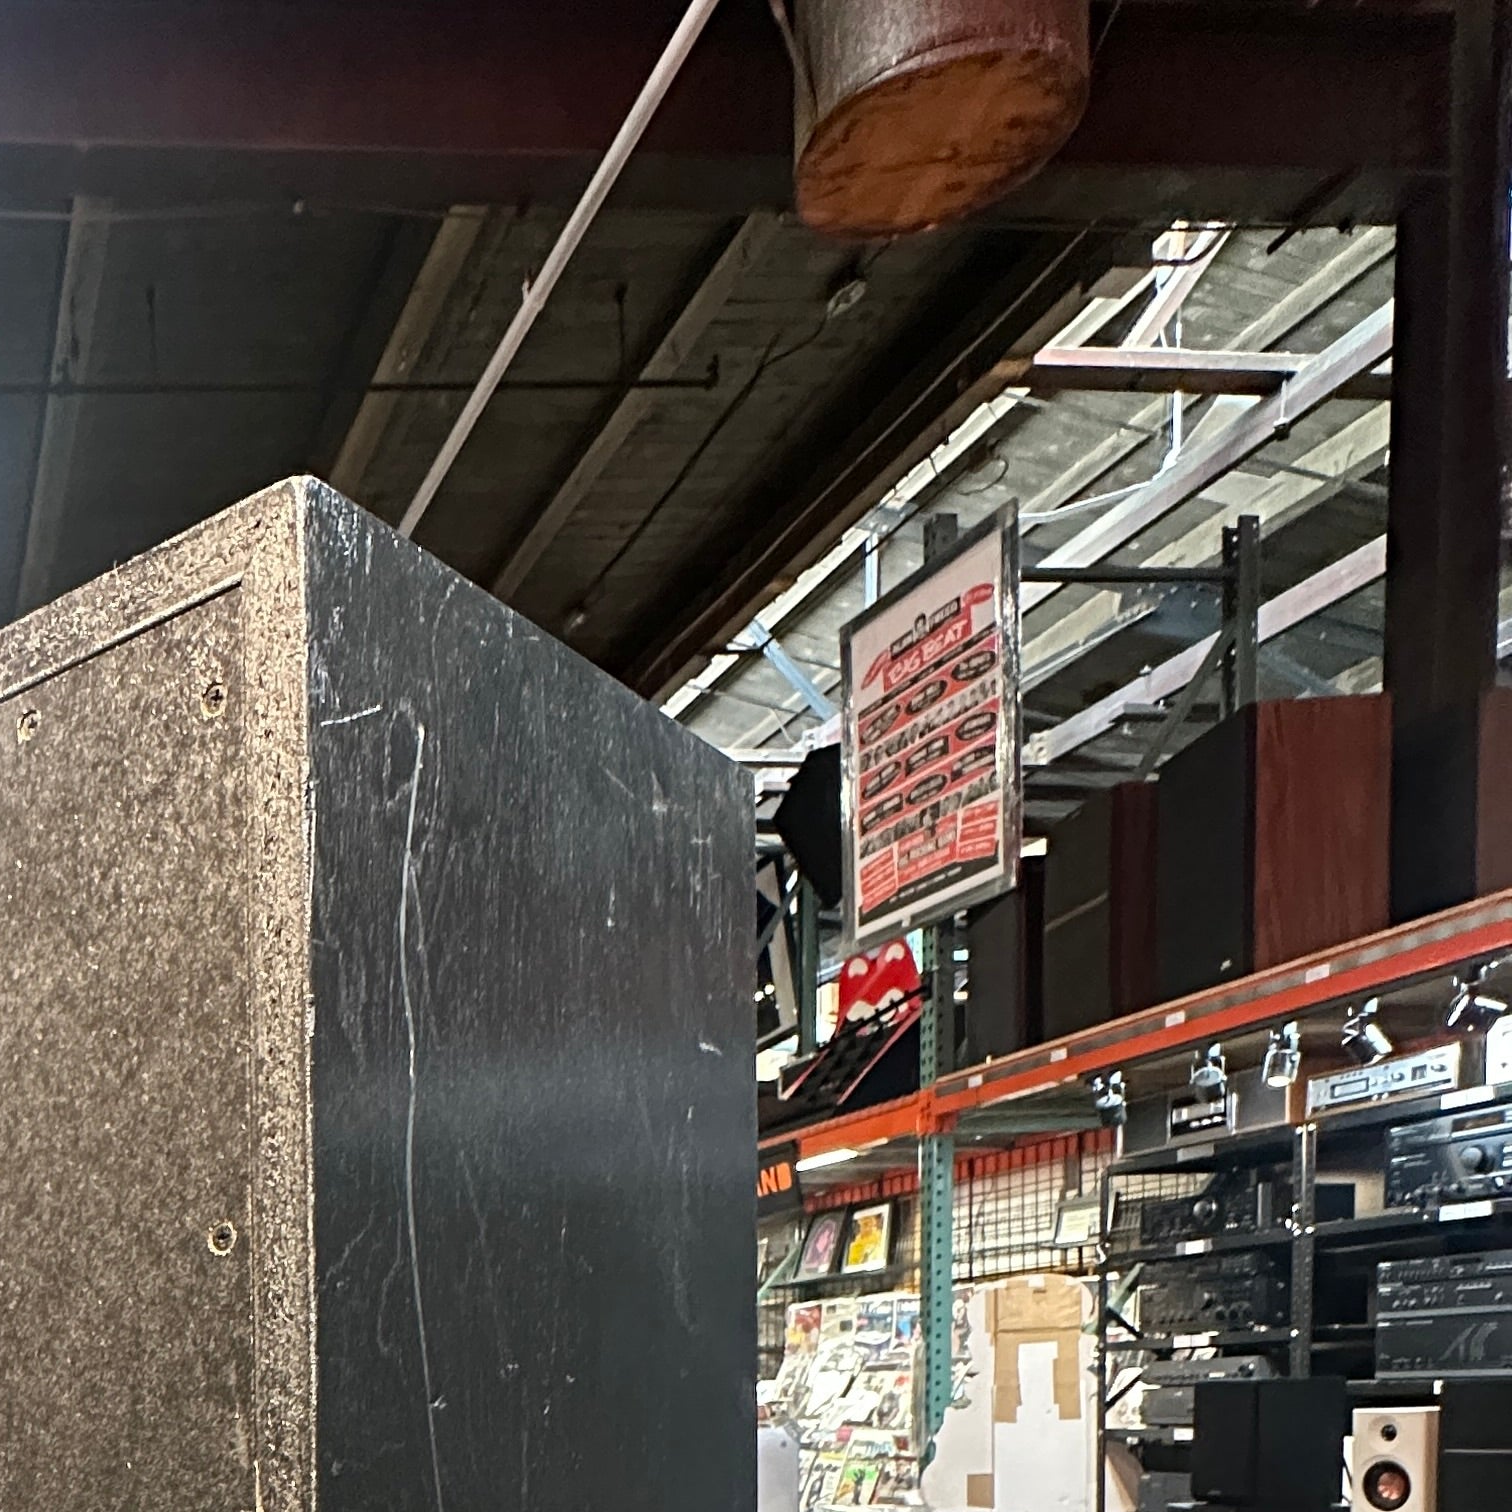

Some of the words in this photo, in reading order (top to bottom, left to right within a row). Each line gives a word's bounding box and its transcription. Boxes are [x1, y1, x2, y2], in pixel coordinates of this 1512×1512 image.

[888, 650, 921, 684] BIG
[921, 619, 968, 661] BEAT
[757, 1162, 792, 1197] ND
